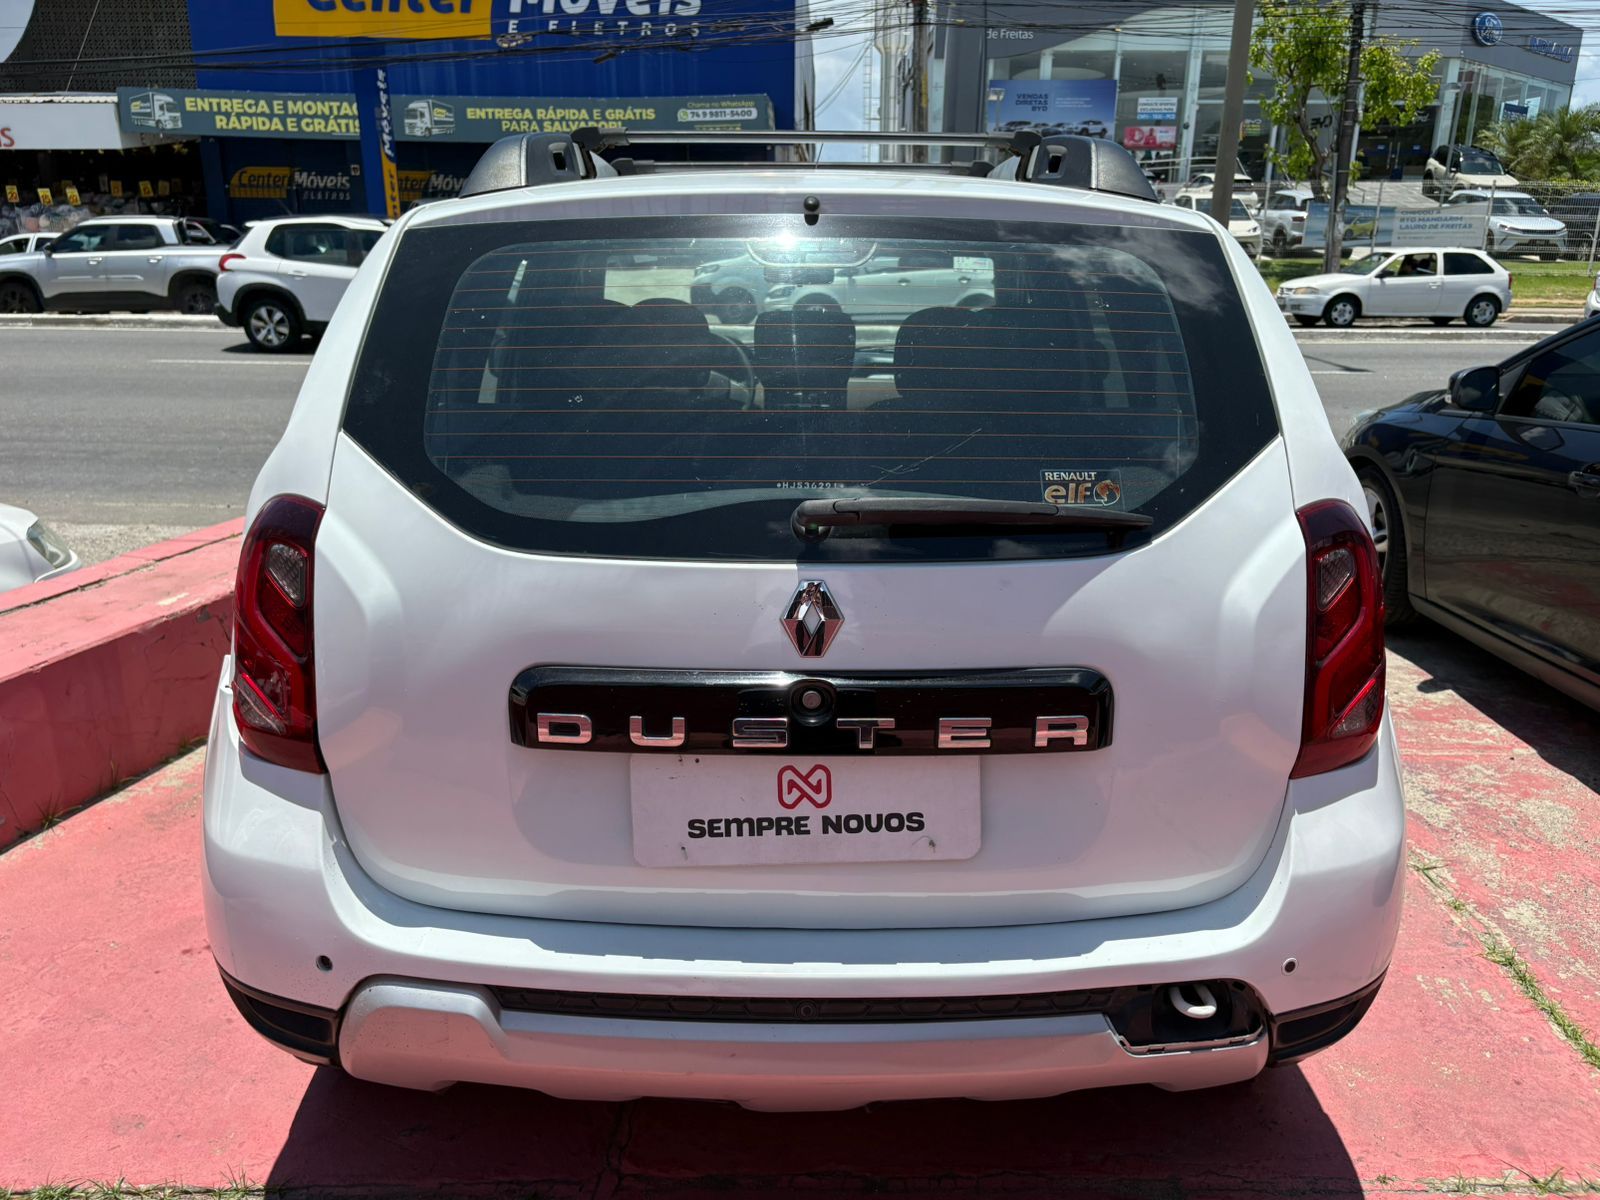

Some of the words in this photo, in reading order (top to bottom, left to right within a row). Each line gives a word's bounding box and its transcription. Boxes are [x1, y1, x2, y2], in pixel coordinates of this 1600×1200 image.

[986, 29, 998, 39] de
[1000, 29, 1034, 39] Freitas
[185, 97, 270, 114] ENTREGA
[273, 100, 285, 115] E
[466, 108, 533, 120] ENTREGA
[536, 105, 589, 120] RÁPIDA
[593, 109, 601, 120] E
[605, 106, 656, 120] GRÁTIS
[215, 112, 283, 131] RÁPIDA
[286, 117, 298, 132] E
[501, 121, 539, 132] PARA
[0, 127, 16, 148] S
[295, 170, 350, 189] Móveis
[428, 173, 464, 192] Móv
[1044, 471, 1097, 480] RENAULT
[1044, 482, 1092, 504] elf
[536, 711, 1091, 751] DUSTER
[687, 814, 810, 839] SEMPRE
[821, 811, 925, 836] NOVOS
